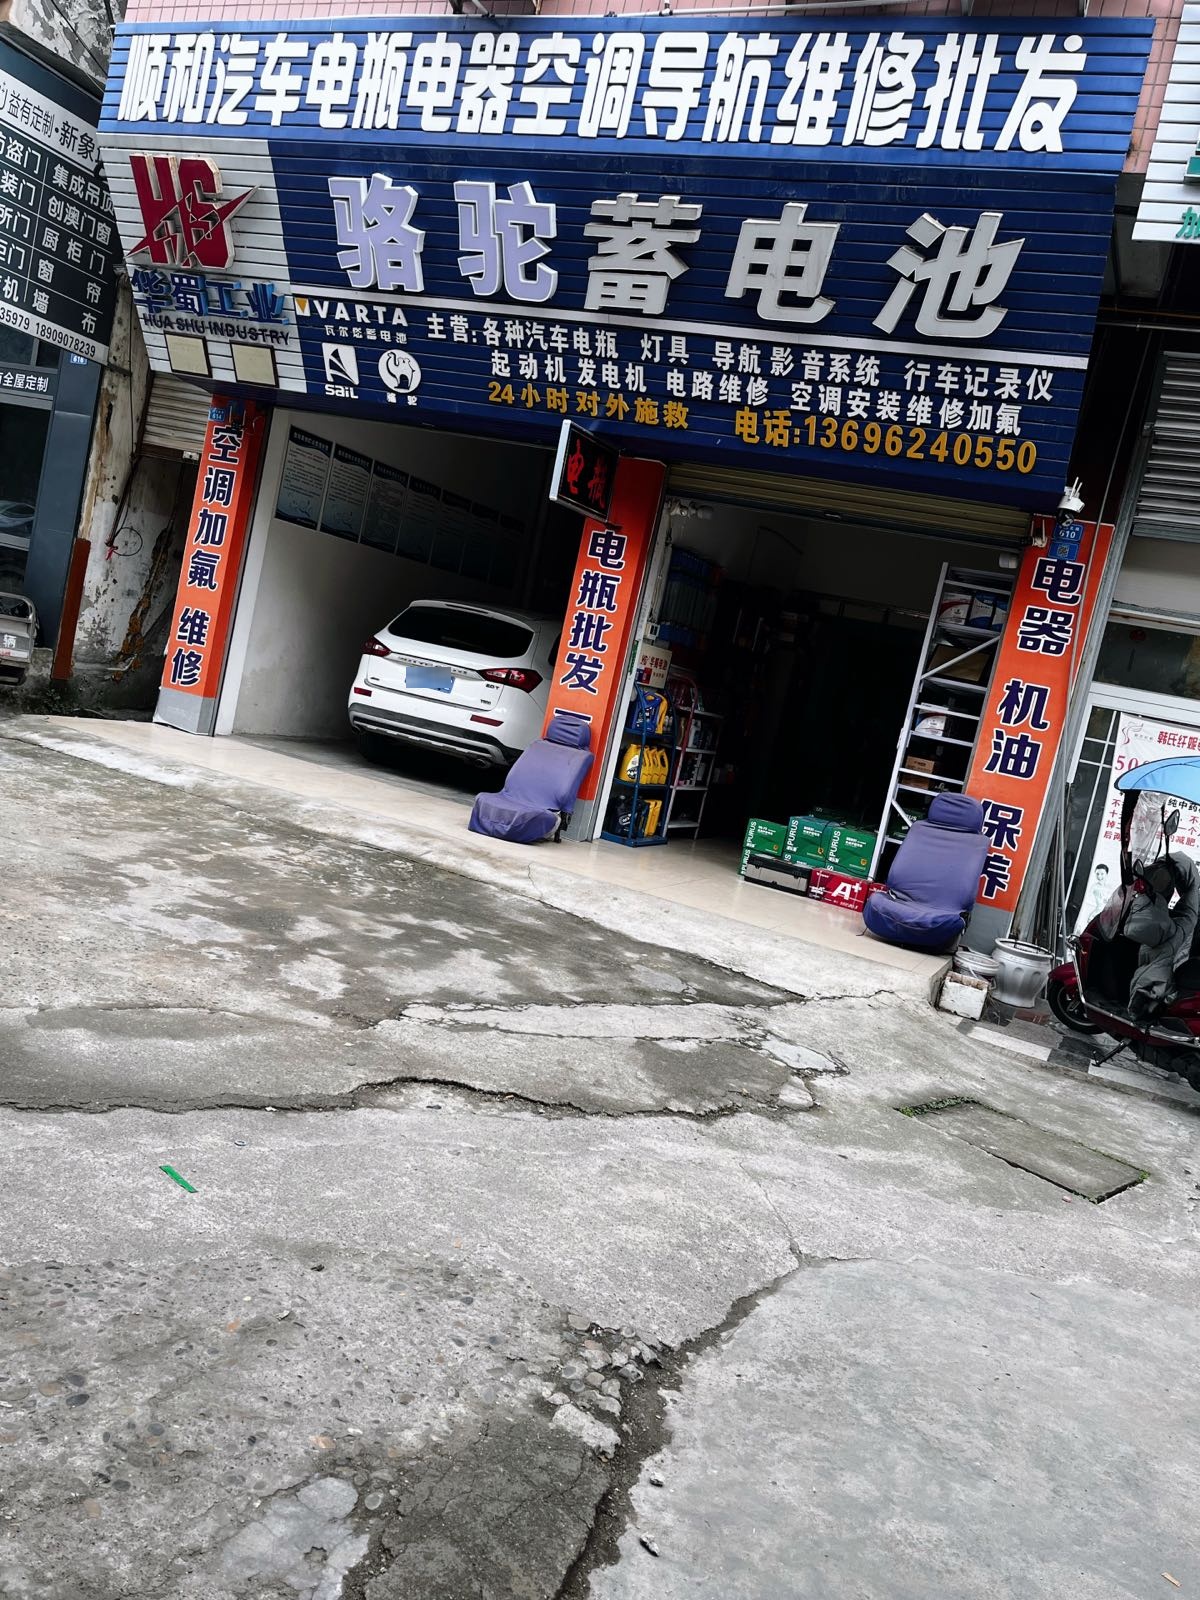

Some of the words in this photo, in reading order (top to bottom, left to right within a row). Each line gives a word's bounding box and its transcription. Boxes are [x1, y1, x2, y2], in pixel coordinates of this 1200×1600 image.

[116, 31, 1087, 154] 顺和汽车电瓶电器空调导航维修批发
[52, 162, 114, 216] 集成吊顶
[328, 172, 1026, 339] 骆驼蓄电池
[131, 266, 289, 325] 华蜀工业
[313, 300, 409, 327] VARTA
[35, 321, 97, 358] 18909078239
[143, 312, 174, 330] HUA
[176, 316, 206, 335] SHU
[208, 320, 291, 346] INDUSTRY
[426, 312, 619, 360] 主营:各种汽车电瓶
[640, 333, 690, 365] 灯具
[711, 341, 881, 387] 导航影音系统
[903, 359, 1054, 402] 行车记录仪
[0, 370, 49, 394] 全屋定制
[490, 349, 567, 384] 起动机
[577, 357, 648, 393] 发电机
[666, 368, 769, 407] 电路维修
[789, 381, 1023, 437] 空调安装维修加氟
[487, 380, 690, 430] 24小时对外施救
[734, 405, 1038, 475] 电话:13696240550
[186, 422, 244, 592] 空调加氟
[1058, 529, 1076, 539] 610
[559, 528, 628, 696] 电瓶批发
[1016, 556, 1086, 658] 电器
[170, 607, 211, 687] 维修
[982, 677, 1052, 782] 机油
[1114, 754, 1150, 773] 50
[787, 819, 799, 846] PURUS
[1167, 797, 1200, 813] 纯中药
[829, 830, 841, 858] PURUS
